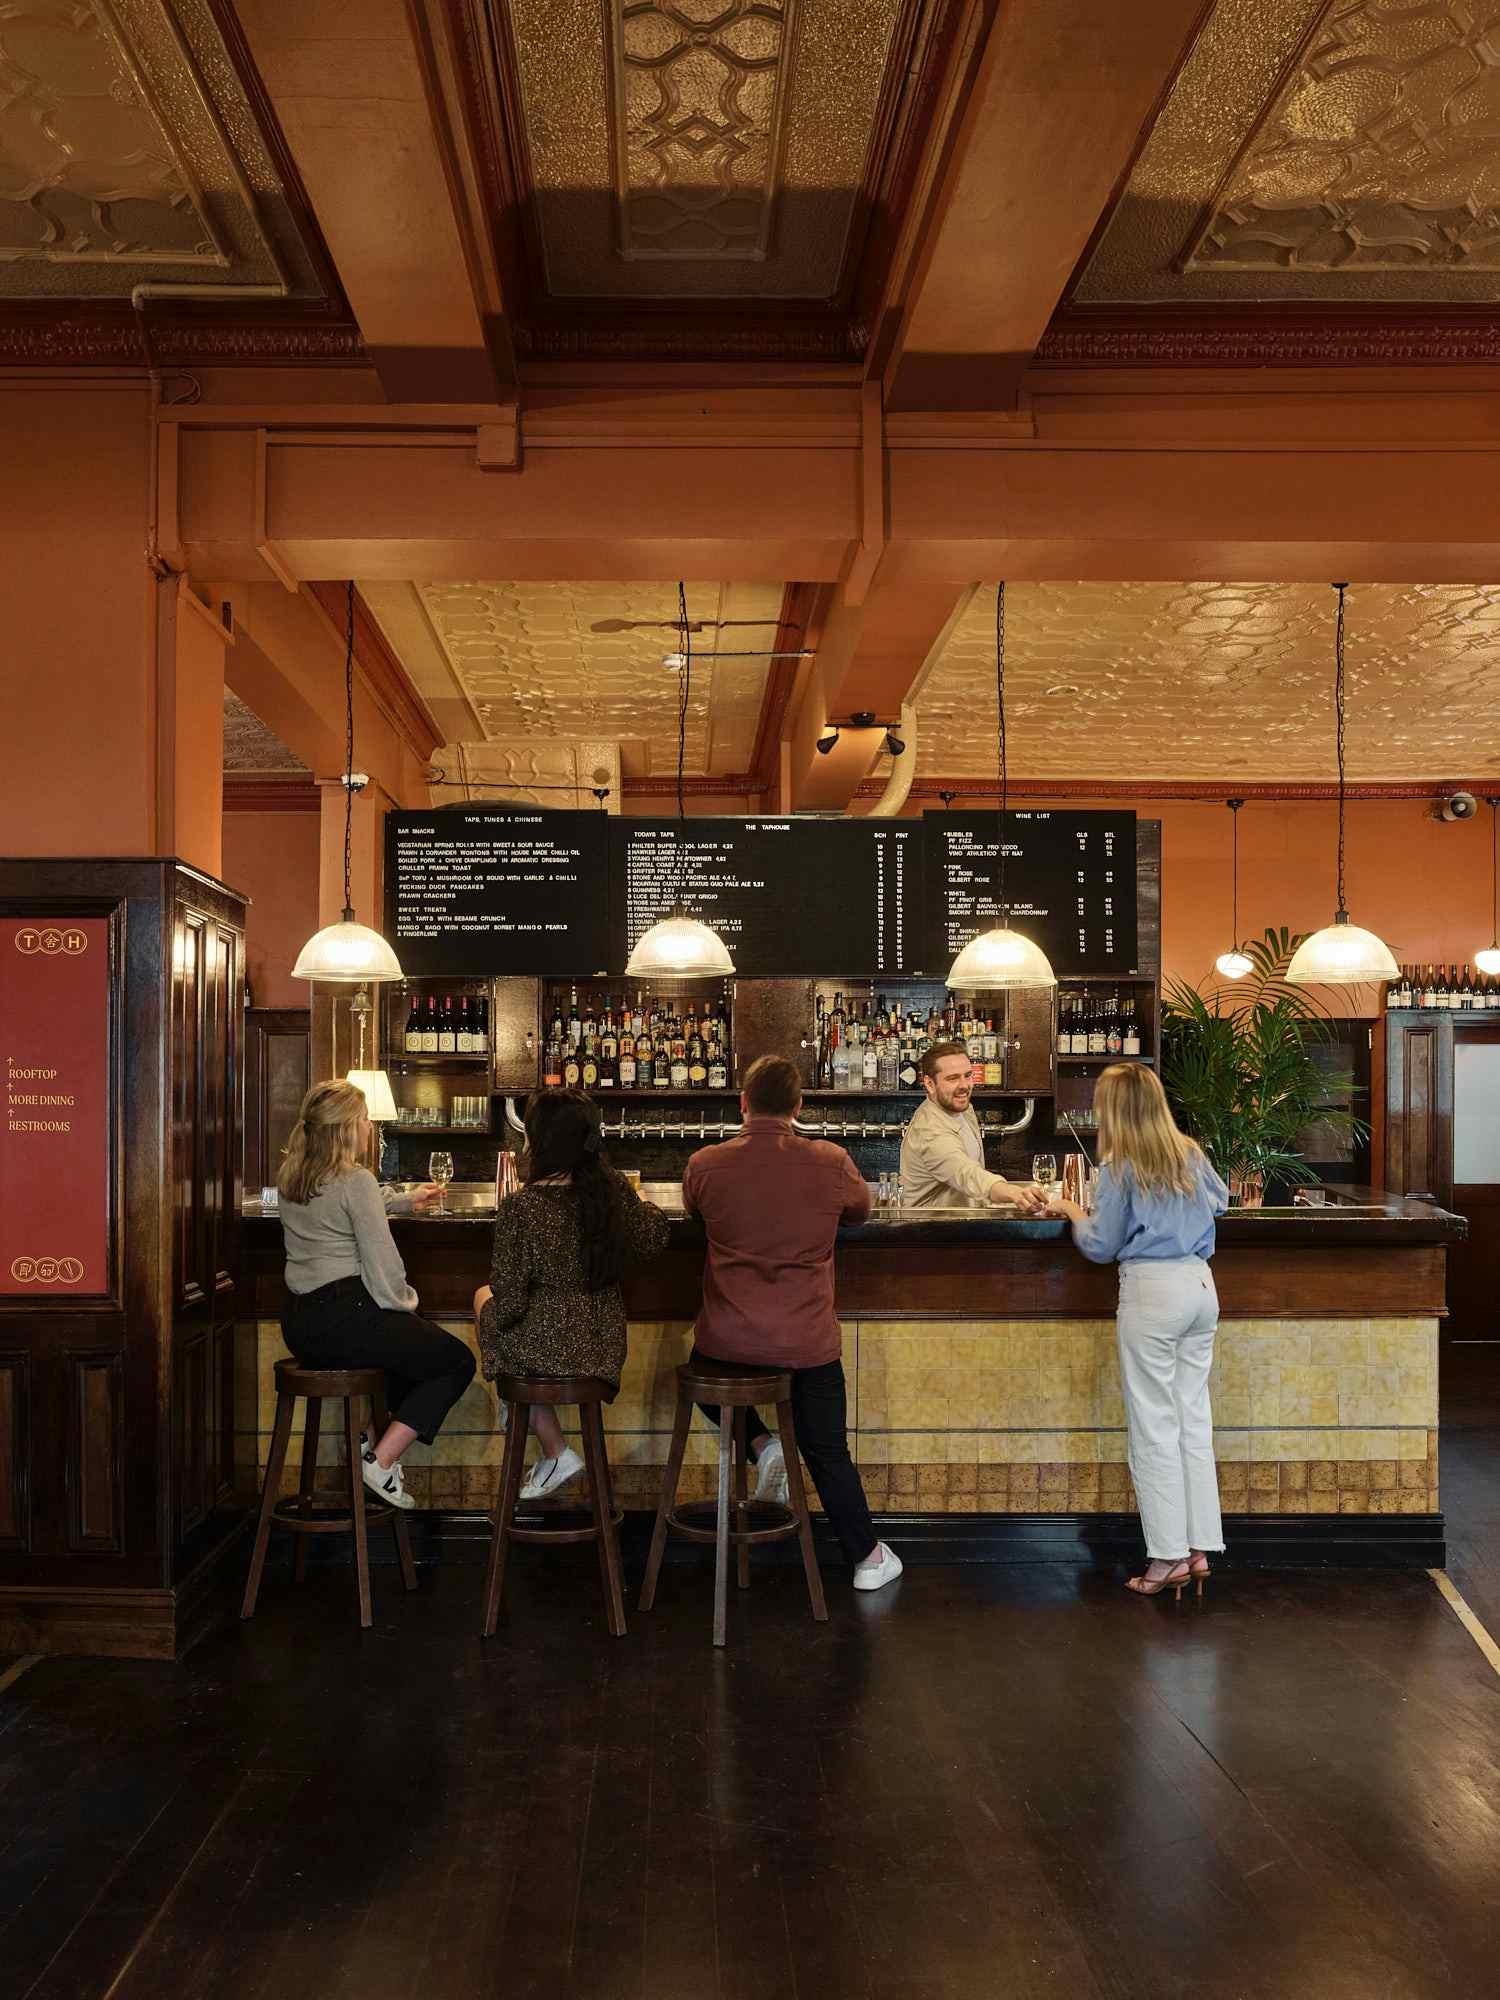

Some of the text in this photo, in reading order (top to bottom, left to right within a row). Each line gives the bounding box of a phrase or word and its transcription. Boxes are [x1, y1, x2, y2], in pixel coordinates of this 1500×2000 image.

[9, 1069, 57, 1080] ROOFTOP
[8, 1094, 75, 1106] MORE DINING
[9, 1120, 71, 1132] RESTROOMS
